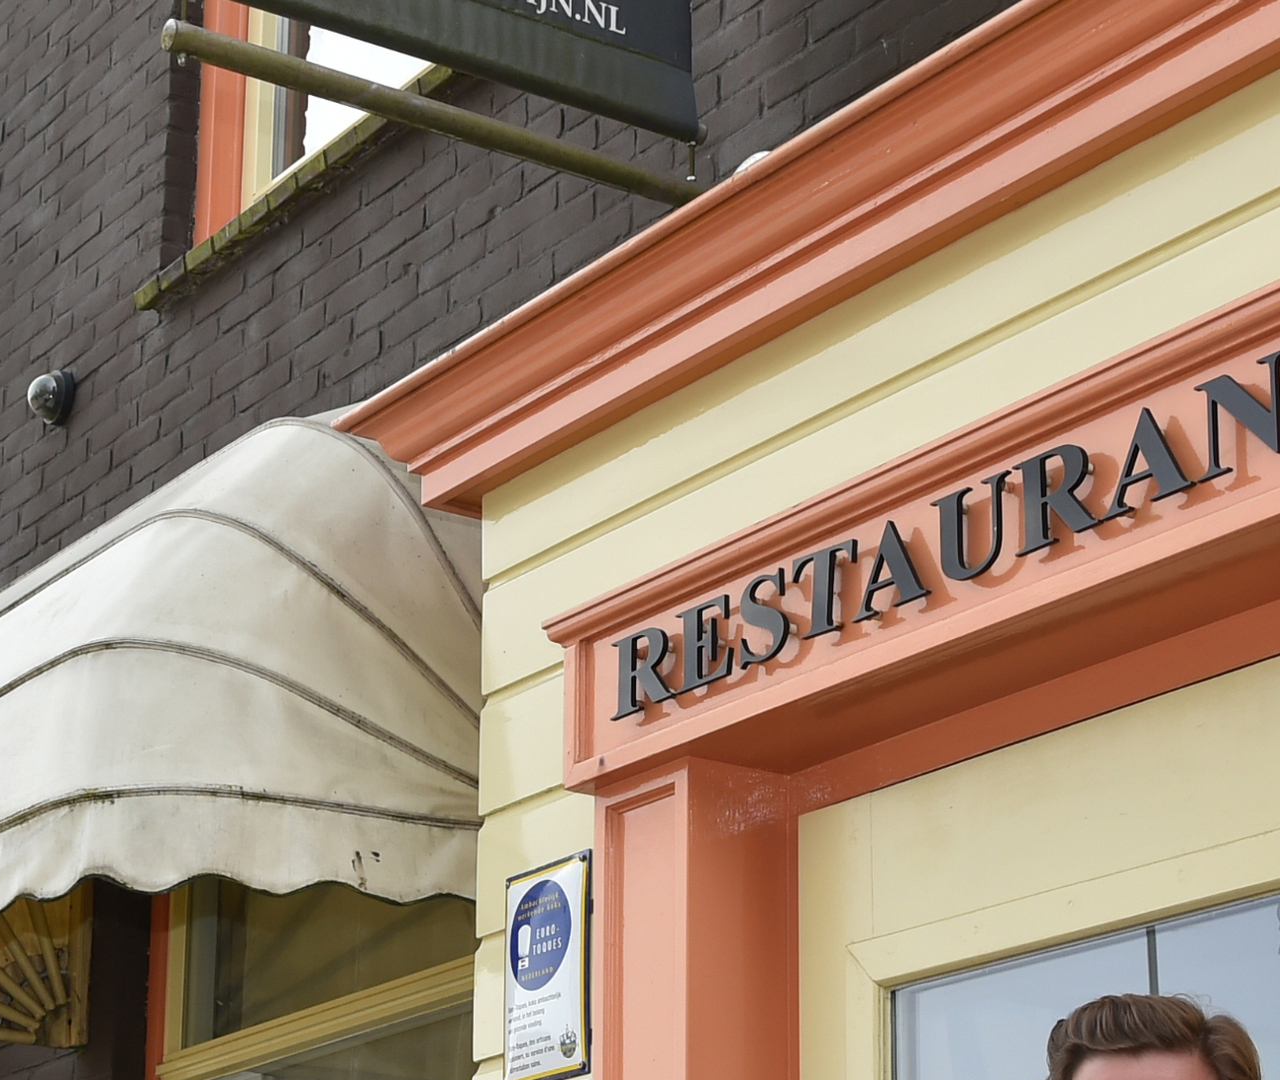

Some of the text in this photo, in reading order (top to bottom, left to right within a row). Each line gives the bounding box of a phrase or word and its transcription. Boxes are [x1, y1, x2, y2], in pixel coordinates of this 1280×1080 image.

[536, 923, 560, 940] EURO-
[532, 937, 562, 956] TOQUES
[521, 966, 554, 982] NEDERLAND
